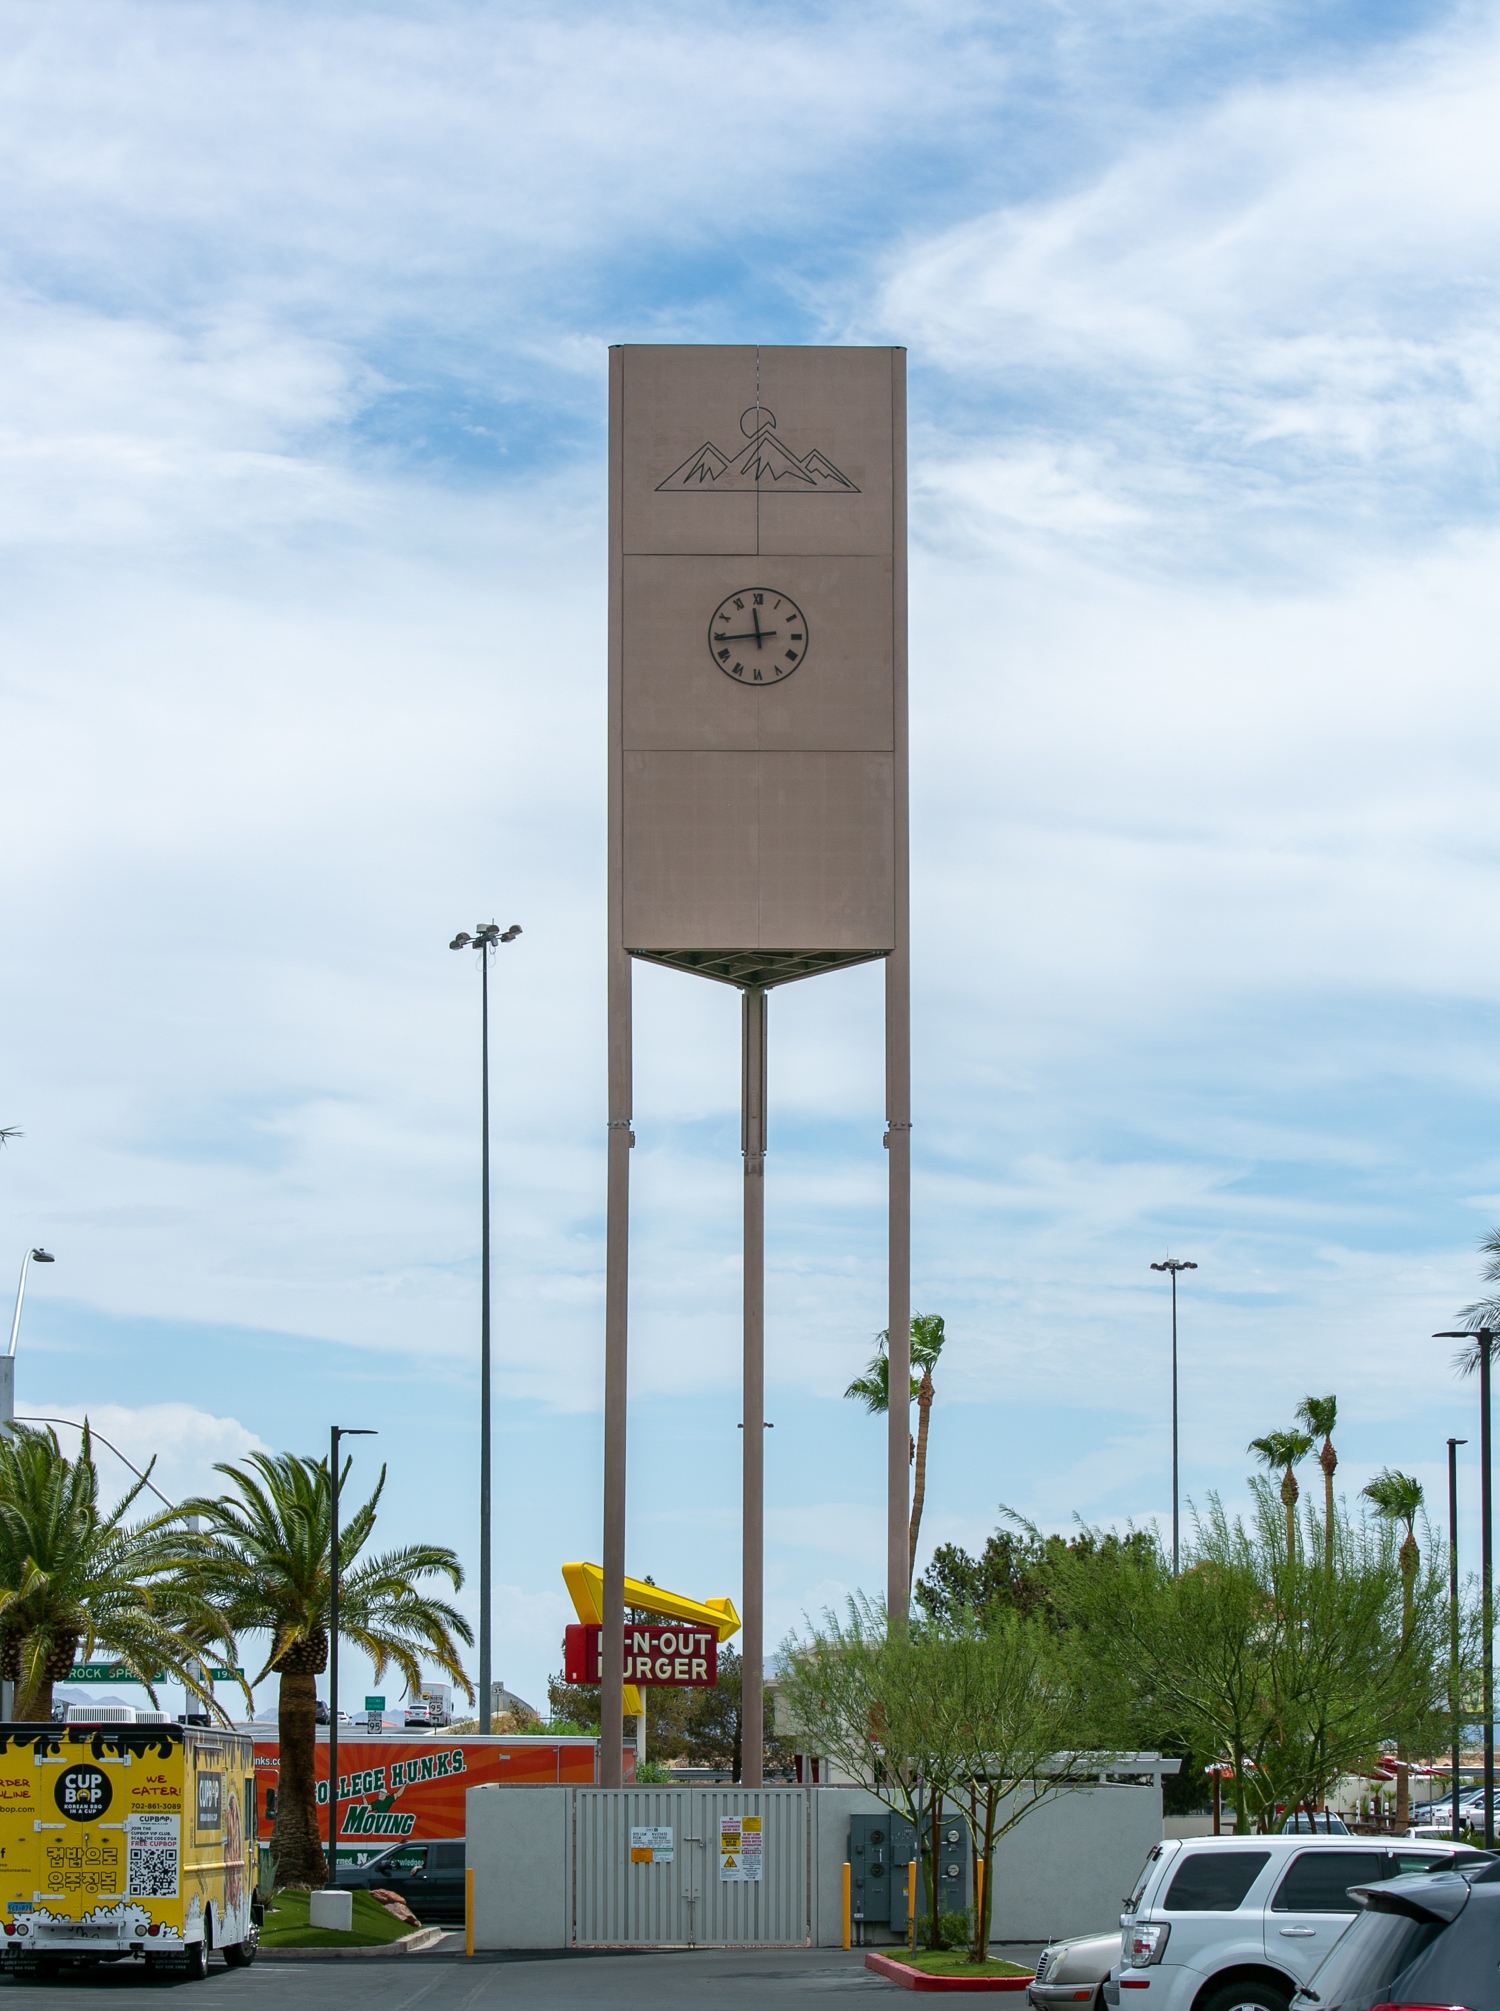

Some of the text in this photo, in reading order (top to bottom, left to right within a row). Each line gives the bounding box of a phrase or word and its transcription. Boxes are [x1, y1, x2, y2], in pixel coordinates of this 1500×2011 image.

[597, 1631, 712, 1656] I-N-OUT
[69, 1668, 162, 1679] ROCK SPRS
[597, 1656, 708, 1680] URGER
[430, 1704, 442, 1712] 95
[369, 1722, 380, 1731] 95
[65, 1774, 102, 1788] CUP
[146, 1774, 167, 1784] WE
[131, 1786, 182, 1796] CATER!
[47, 1847, 118, 1868] 컵밥으로
[48, 1872, 117, 1893] 우주정복
